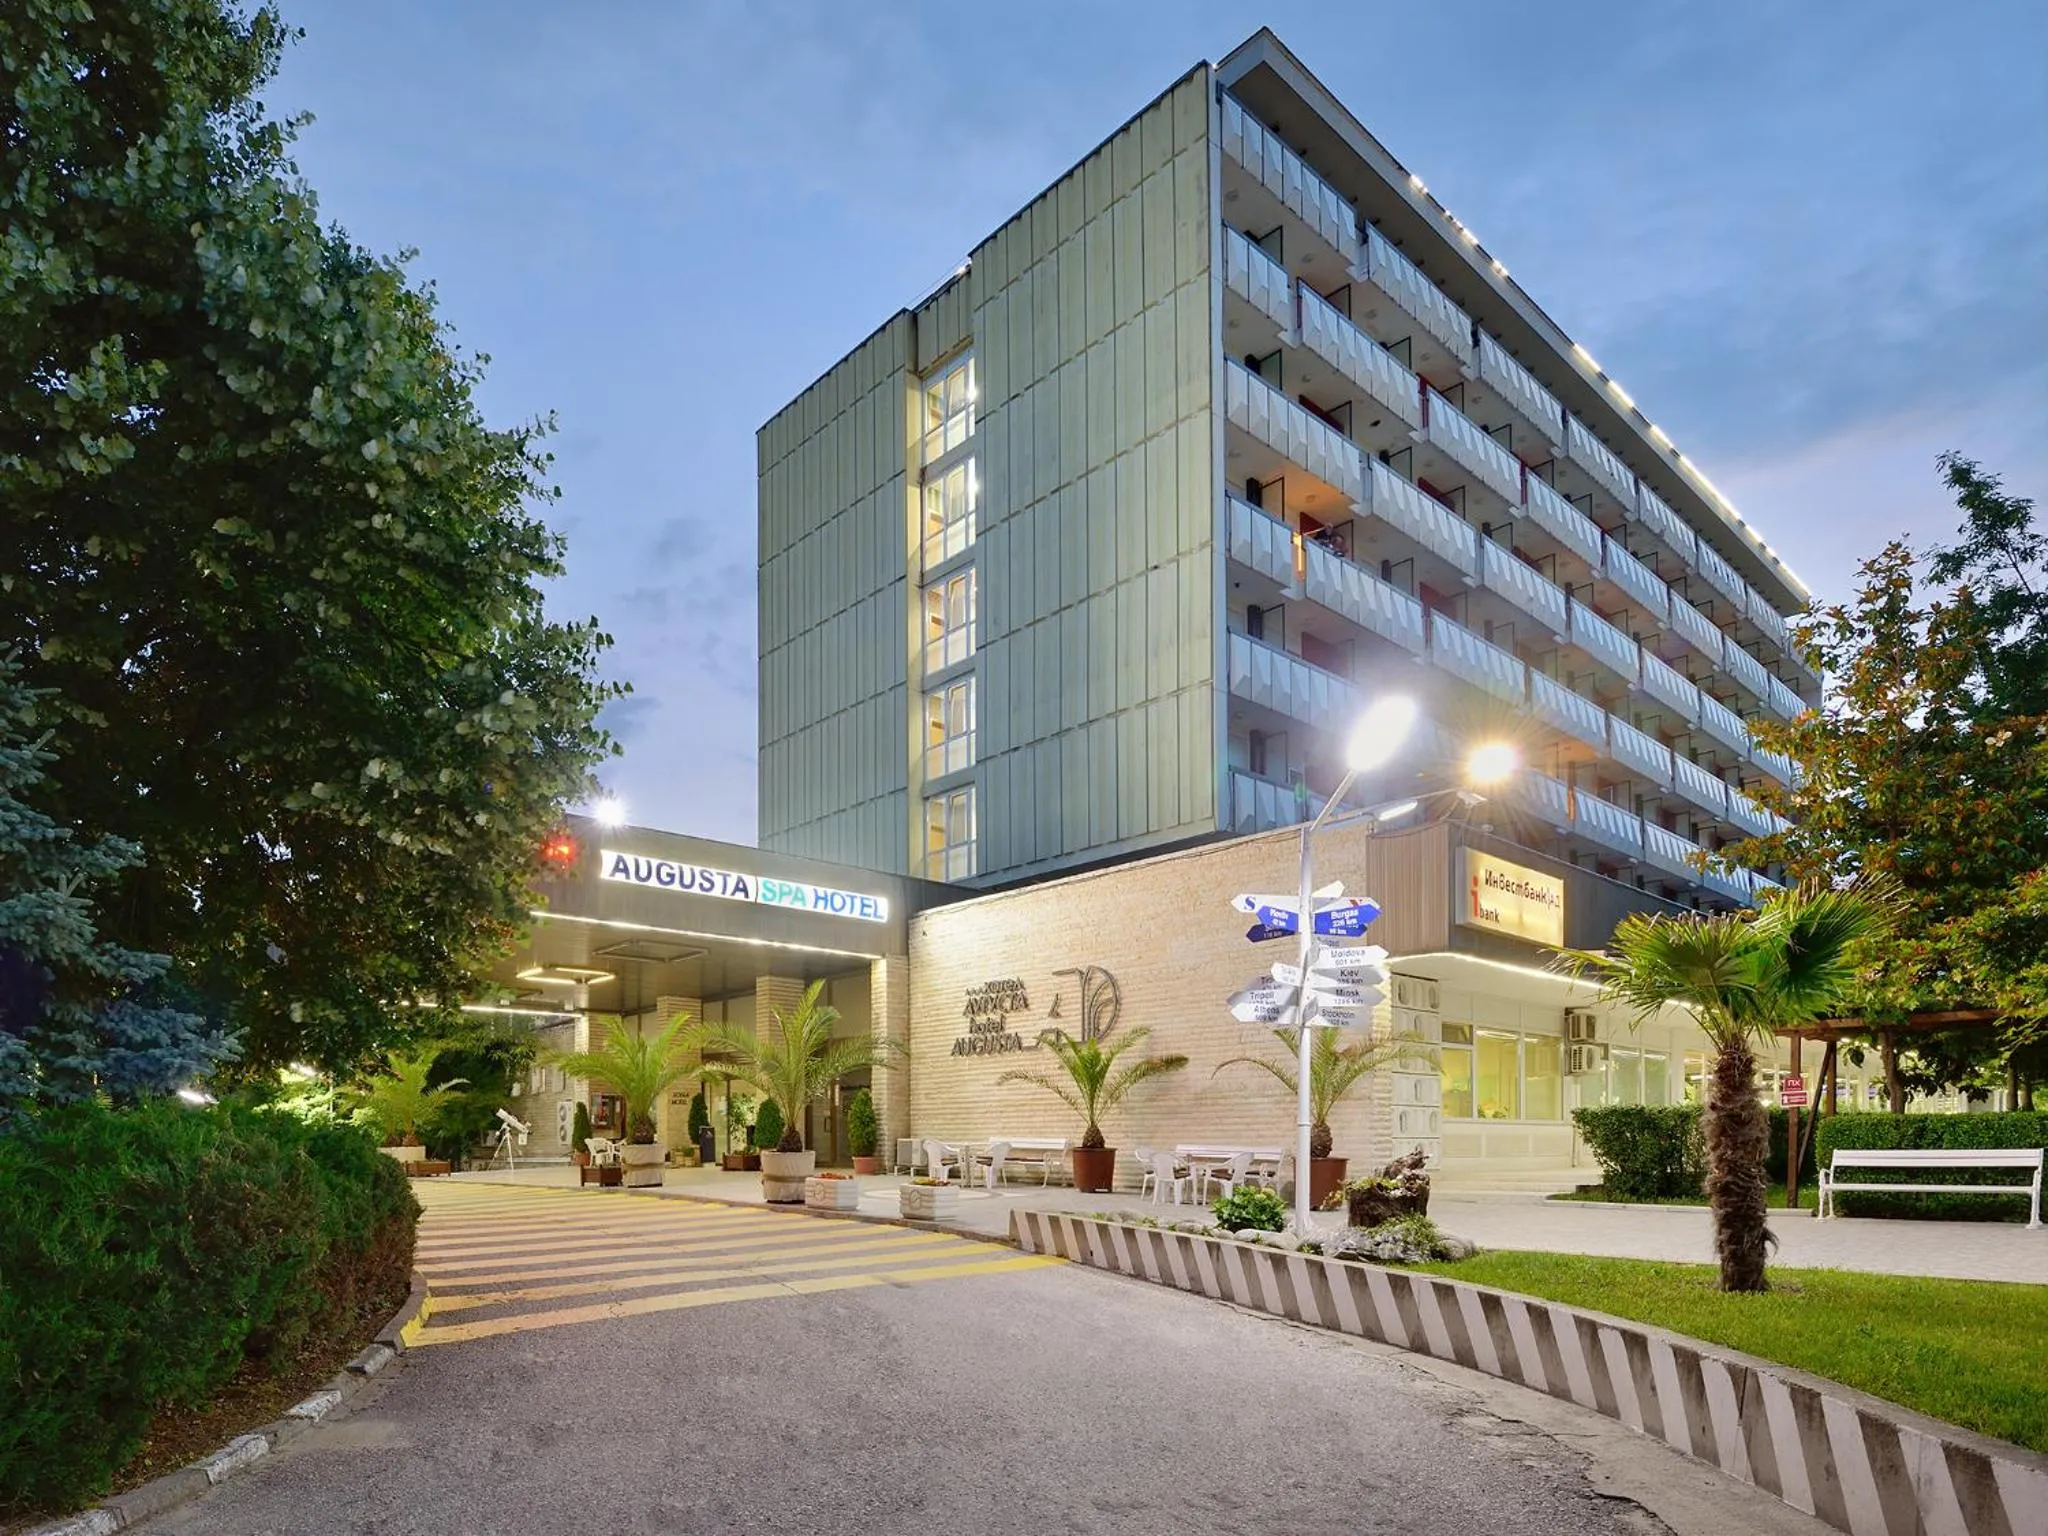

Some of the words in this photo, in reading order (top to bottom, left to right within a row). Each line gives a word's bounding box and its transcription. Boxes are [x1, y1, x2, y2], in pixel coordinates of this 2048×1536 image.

[609, 854, 750, 899] AUGUSTA
[761, 880, 807, 907] SPA
[812, 887, 885, 920] HOTEL
[1330, 909, 1359, 920] Burgas
[1340, 969, 1360, 977] Kiev
[969, 1013, 1005, 1034] hotel
[951, 1031, 1022, 1057] AUGUSTA
